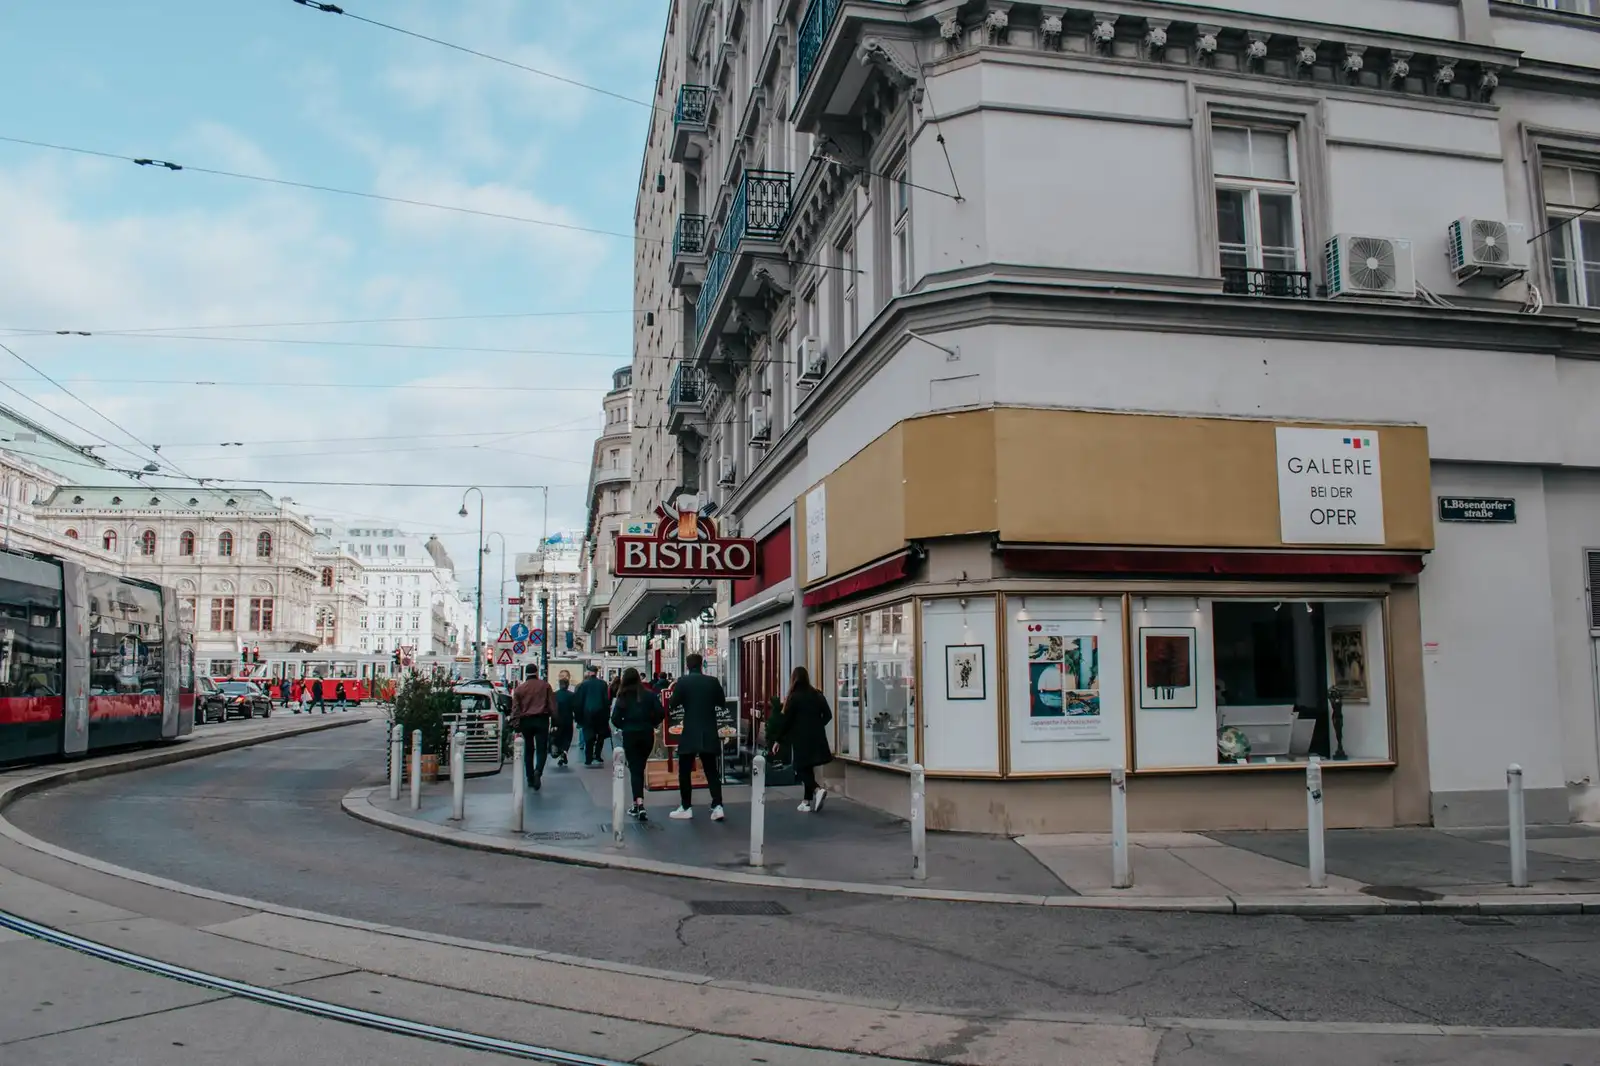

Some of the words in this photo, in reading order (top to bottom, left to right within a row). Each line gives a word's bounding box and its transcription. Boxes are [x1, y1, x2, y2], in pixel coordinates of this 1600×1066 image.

[1288, 457, 1372, 475] GALERIE
[1311, 486, 1327, 497] BEI
[1331, 486, 1353, 498] DER
[1310, 508, 1357, 525] OPER
[624, 541, 751, 571] BISTRO
